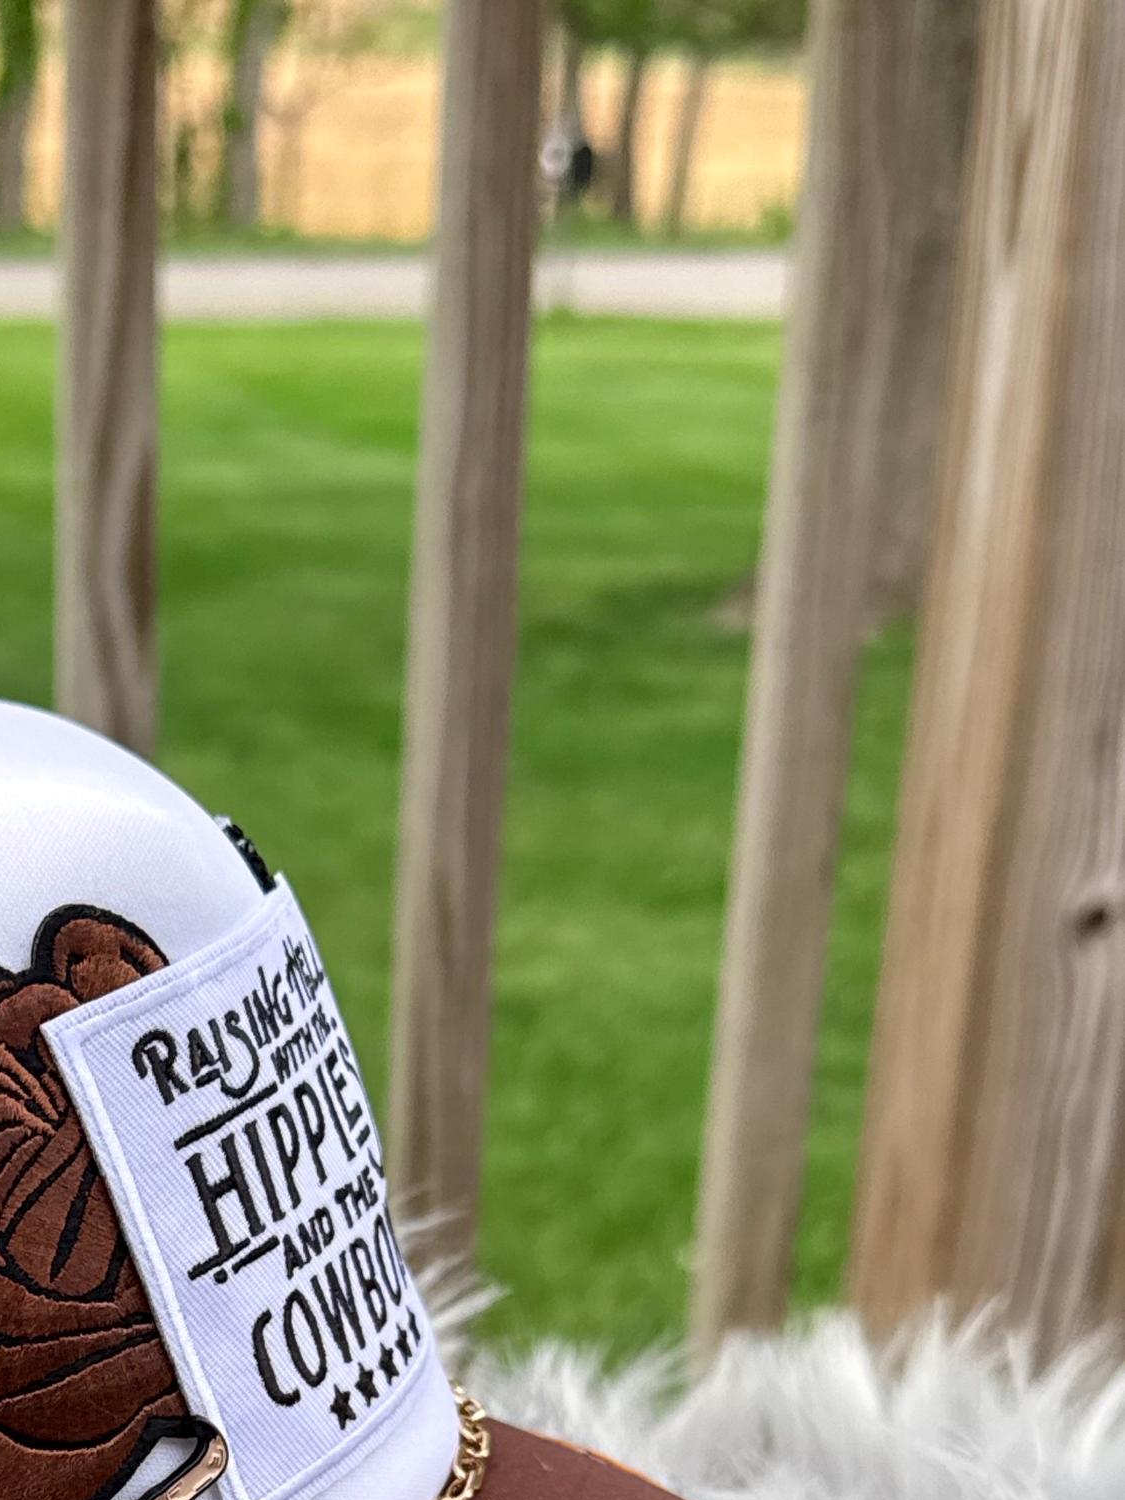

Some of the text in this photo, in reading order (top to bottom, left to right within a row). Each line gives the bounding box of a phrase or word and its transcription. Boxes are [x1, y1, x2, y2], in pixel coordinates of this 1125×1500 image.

[132, 934, 324, 1105] RAISING HELL
[271, 1022, 318, 1084] WITH
[282, 1166, 378, 1280] AND THE
[252, 1207, 407, 1407] COWBO
